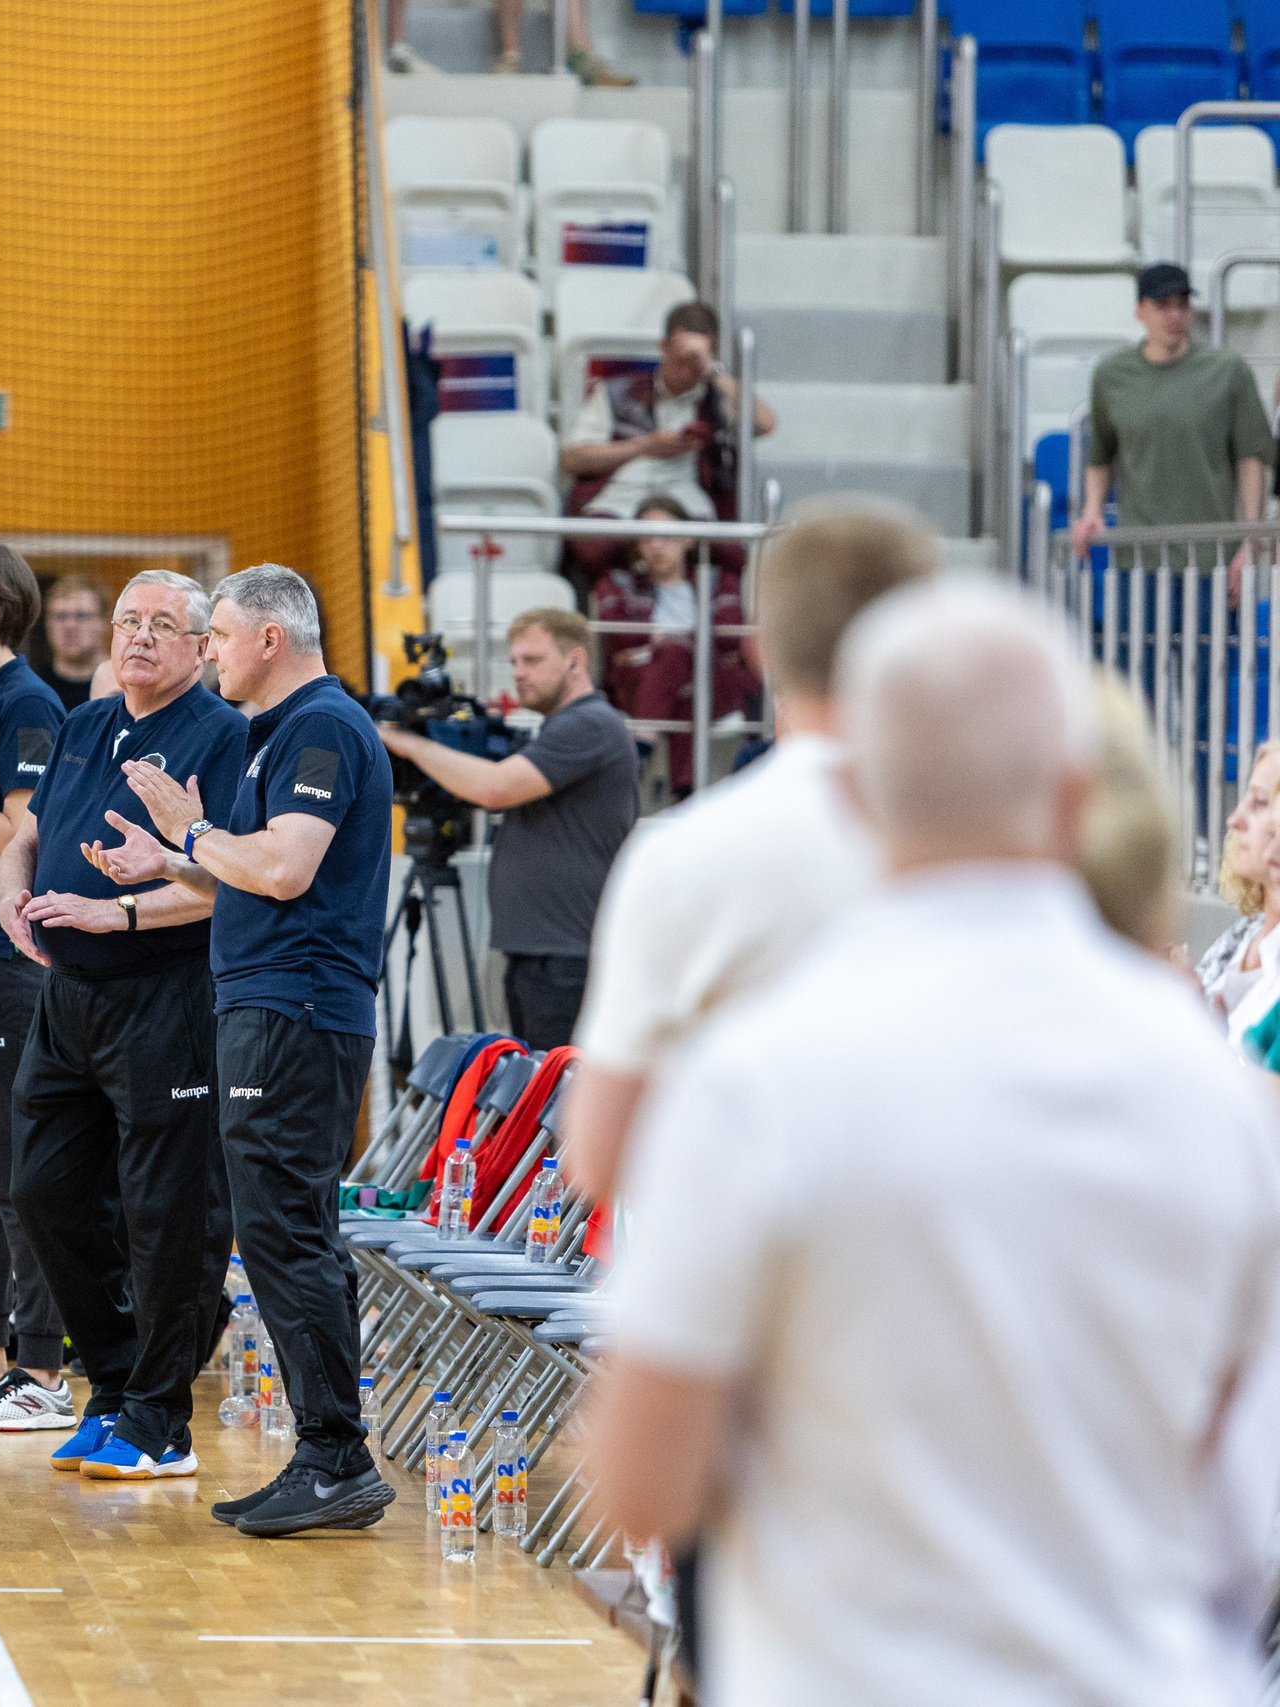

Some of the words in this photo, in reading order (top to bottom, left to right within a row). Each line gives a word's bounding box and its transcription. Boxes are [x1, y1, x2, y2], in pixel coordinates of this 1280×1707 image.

[17, 761, 46, 775] Kemp
[294, 783, 332, 799] Kempa
[171, 1085, 209, 1099] Kempa
[229, 1086, 263, 1100] Kempa
[532, 1206, 550, 1245] 202
[244, 1340, 258, 1374] 202
[428, 1435, 436, 1484] CLASSIC
[497, 1464, 513, 1504] 202
[451, 1478, 472, 1527] 202
